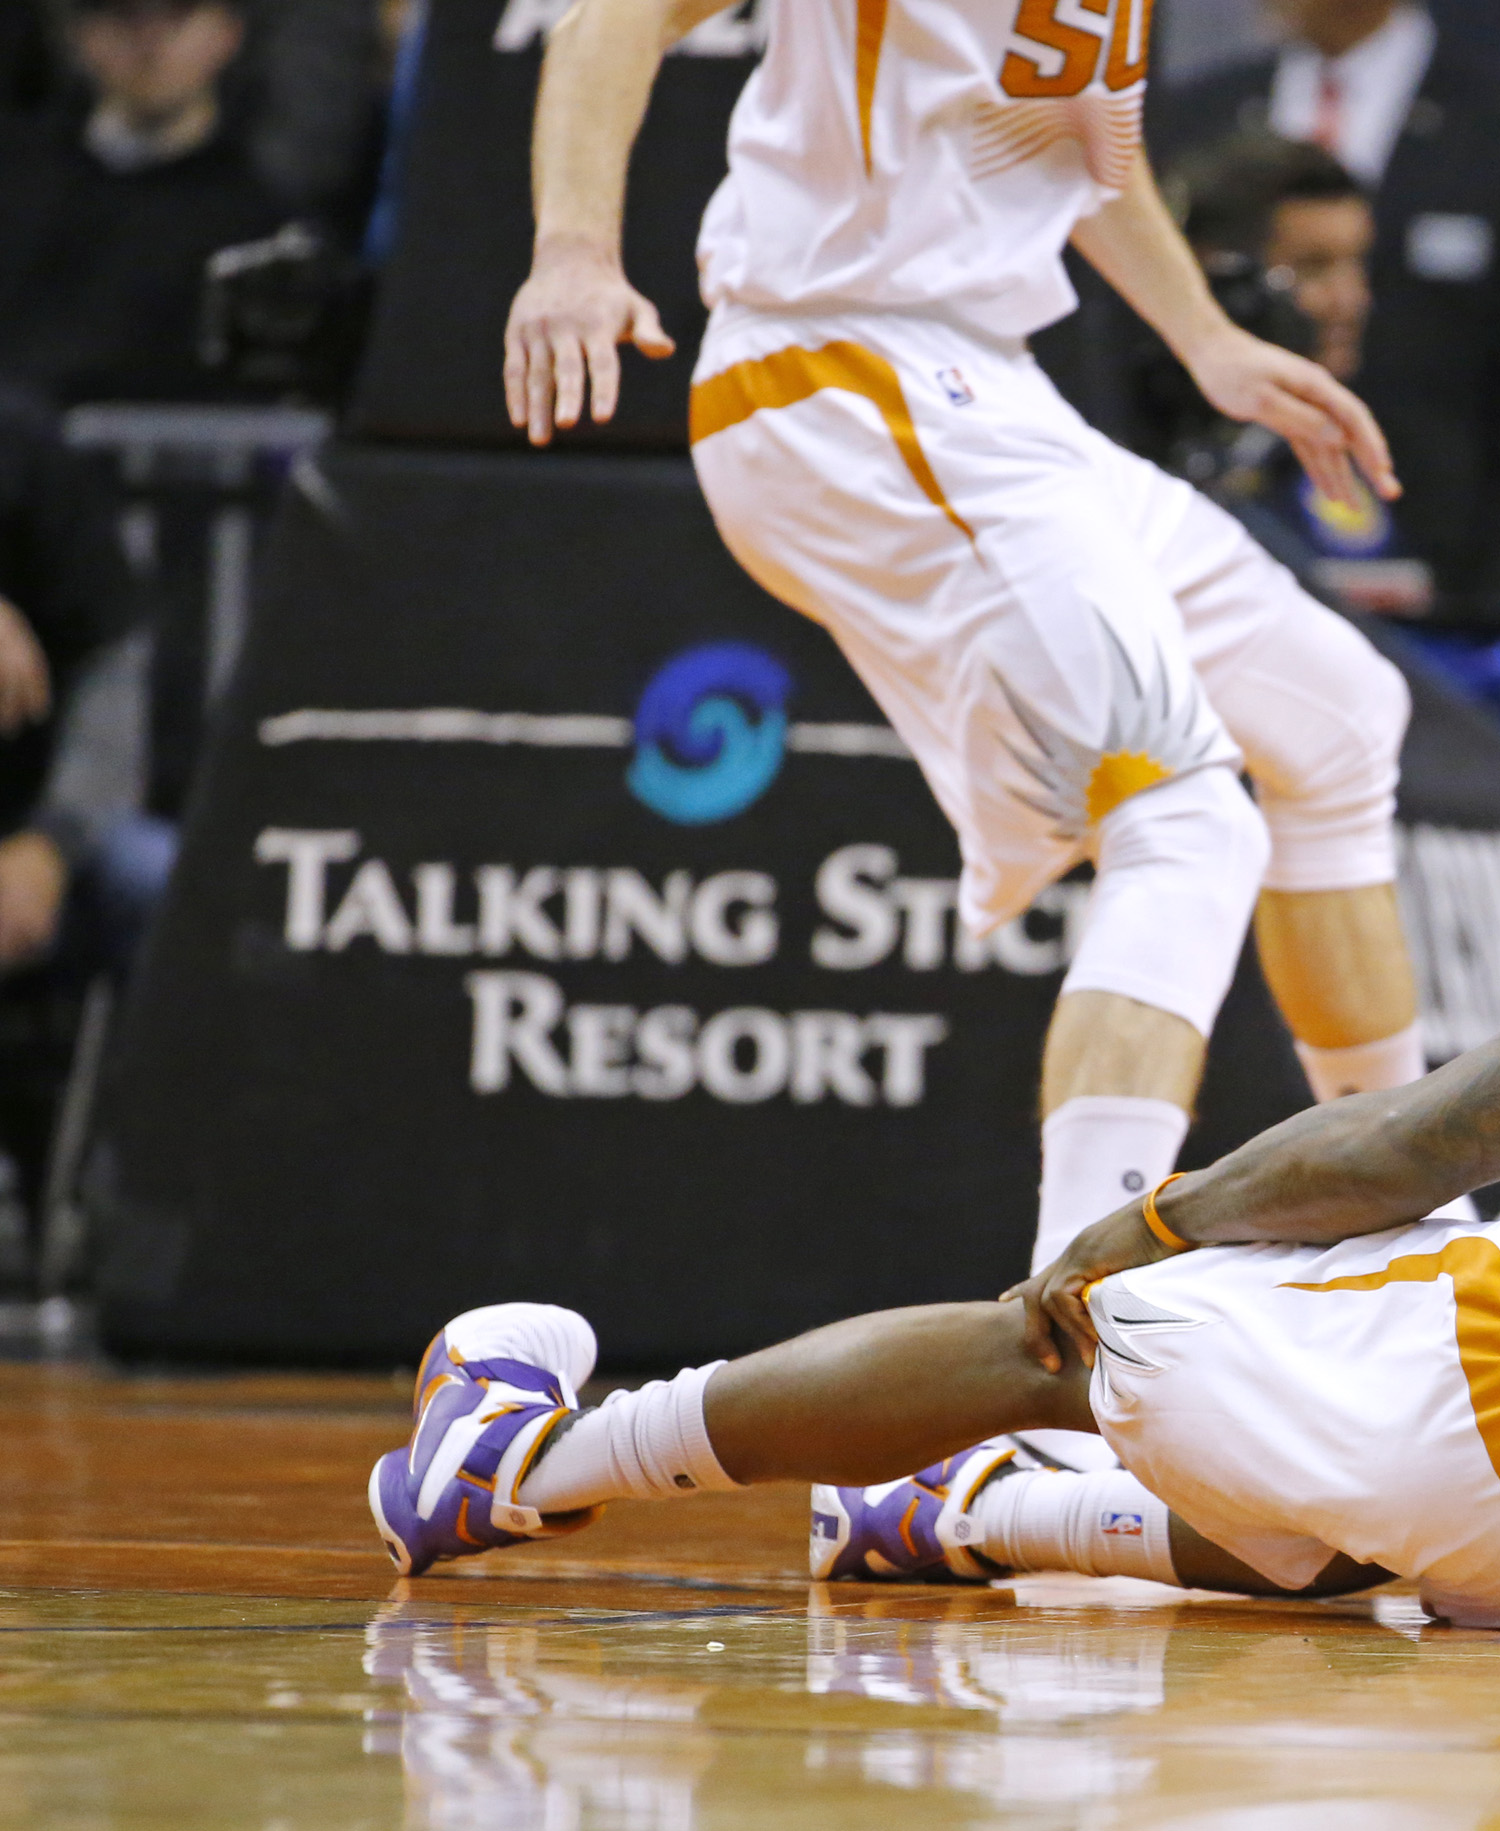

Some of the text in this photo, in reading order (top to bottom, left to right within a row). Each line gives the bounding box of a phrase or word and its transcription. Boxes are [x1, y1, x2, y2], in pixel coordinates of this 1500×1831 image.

[254, 826, 1092, 975] TALKING STIC
[463, 967, 948, 1106] RESORT
